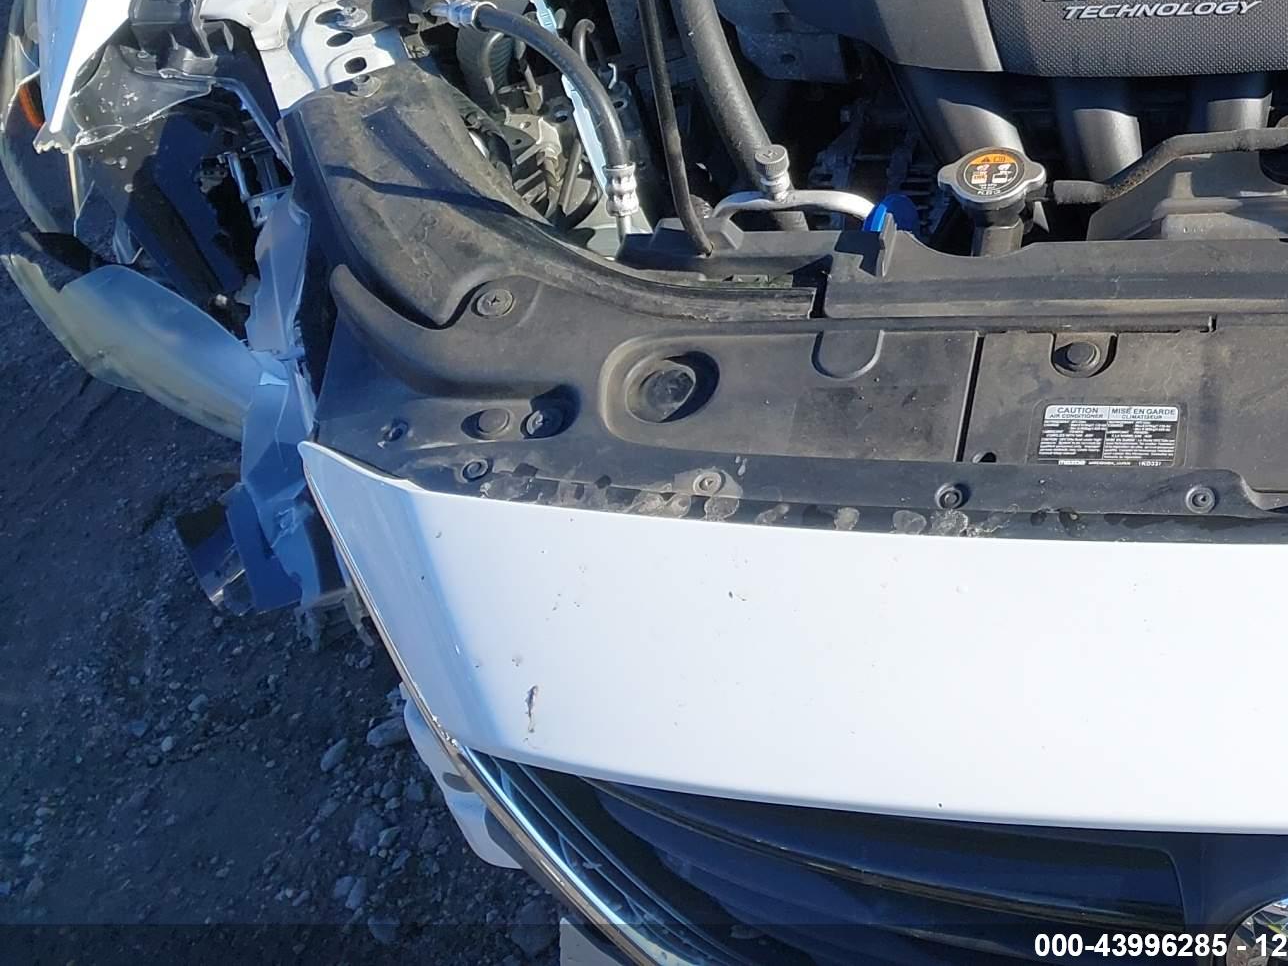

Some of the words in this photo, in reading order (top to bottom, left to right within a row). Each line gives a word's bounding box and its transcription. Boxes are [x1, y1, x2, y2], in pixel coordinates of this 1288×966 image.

[1064, 0, 1262, 20] TECHNOLOGY
[1057, 406, 1099, 414] CAUTION
[1111, 407, 1132, 415] MISE
[1146, 408, 1175, 416] GARDE
